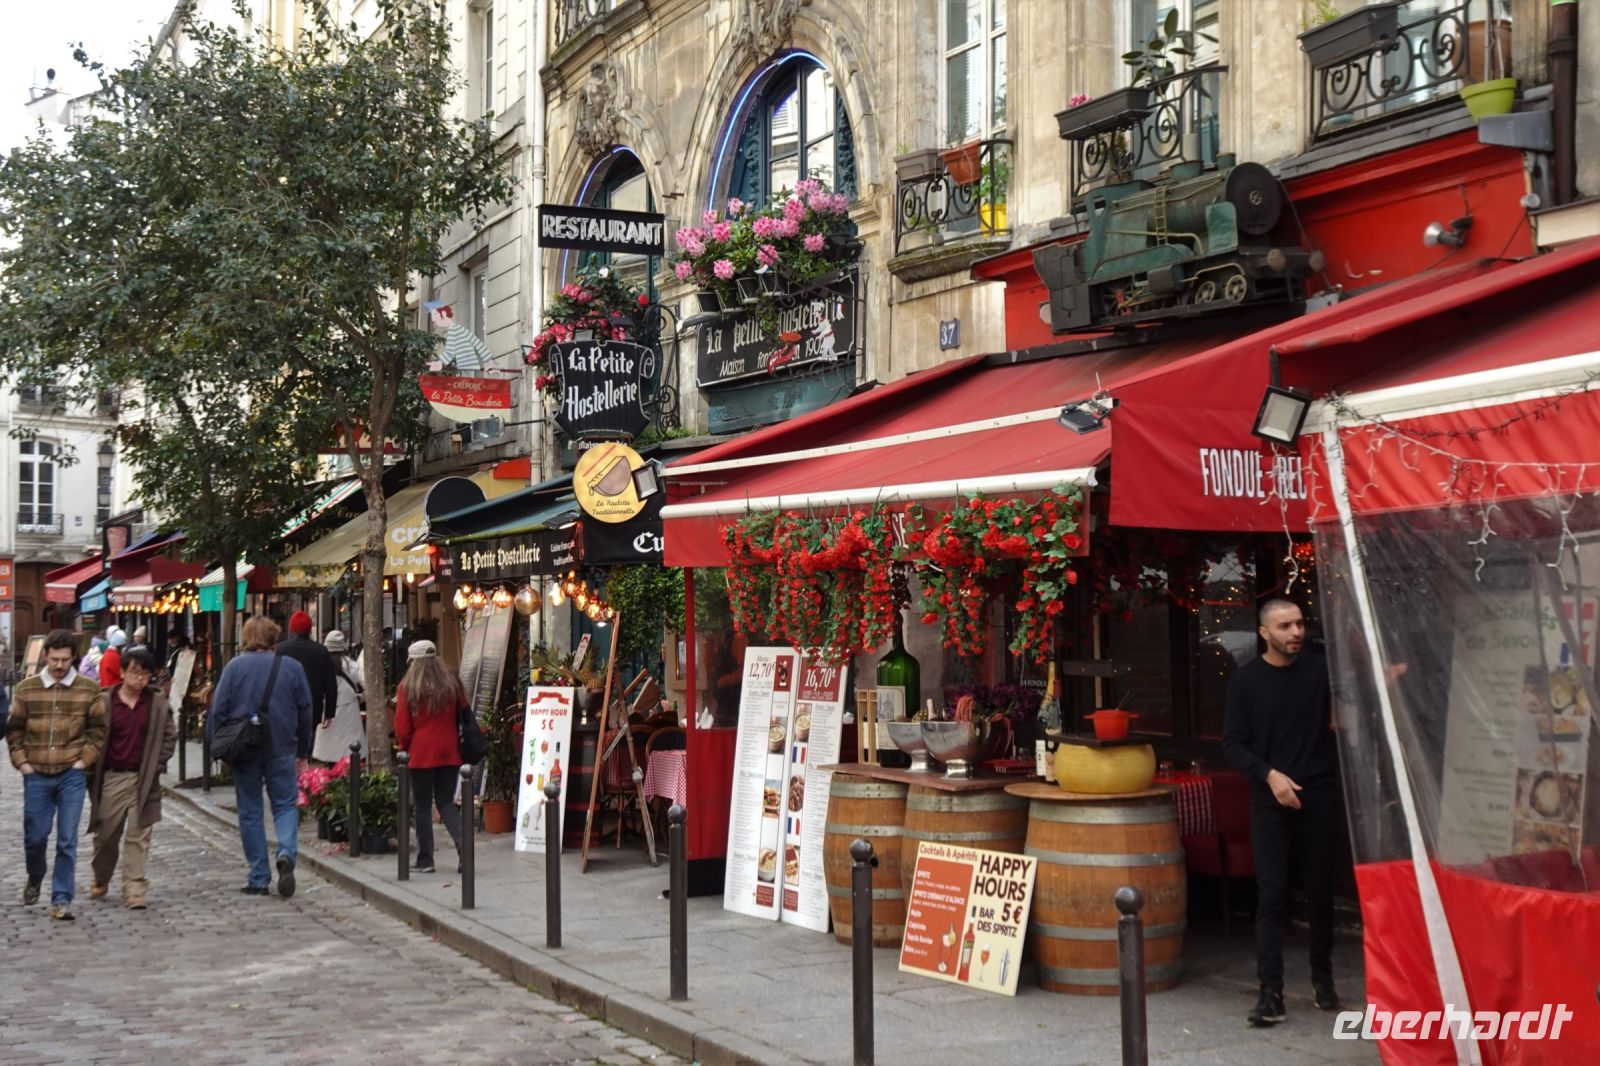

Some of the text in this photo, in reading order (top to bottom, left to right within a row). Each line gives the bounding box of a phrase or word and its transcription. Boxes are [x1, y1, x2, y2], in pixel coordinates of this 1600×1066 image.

[542, 213, 663, 246] RESTAURANT
[941, 323, 956, 346] 37
[568, 346, 634, 374] La Petite
[719, 358, 745, 377] Maison
[566, 379, 637, 422] Hostellerie
[1200, 448, 1266, 498] FONDUE
[473, 550, 496, 574] Petite
[530, 708, 568, 717] HAPPY HOUR
[920, 844, 945, 857] Cocktails
[952, 849, 977, 862] Apéritifs
[979, 854, 1032, 879] HAPPY
[974, 876, 1027, 901] HOURS
[979, 907, 995, 919] BAR
[1001, 903, 1023, 925] 5 €
[977, 920, 1018, 938] DES SPRITZ
